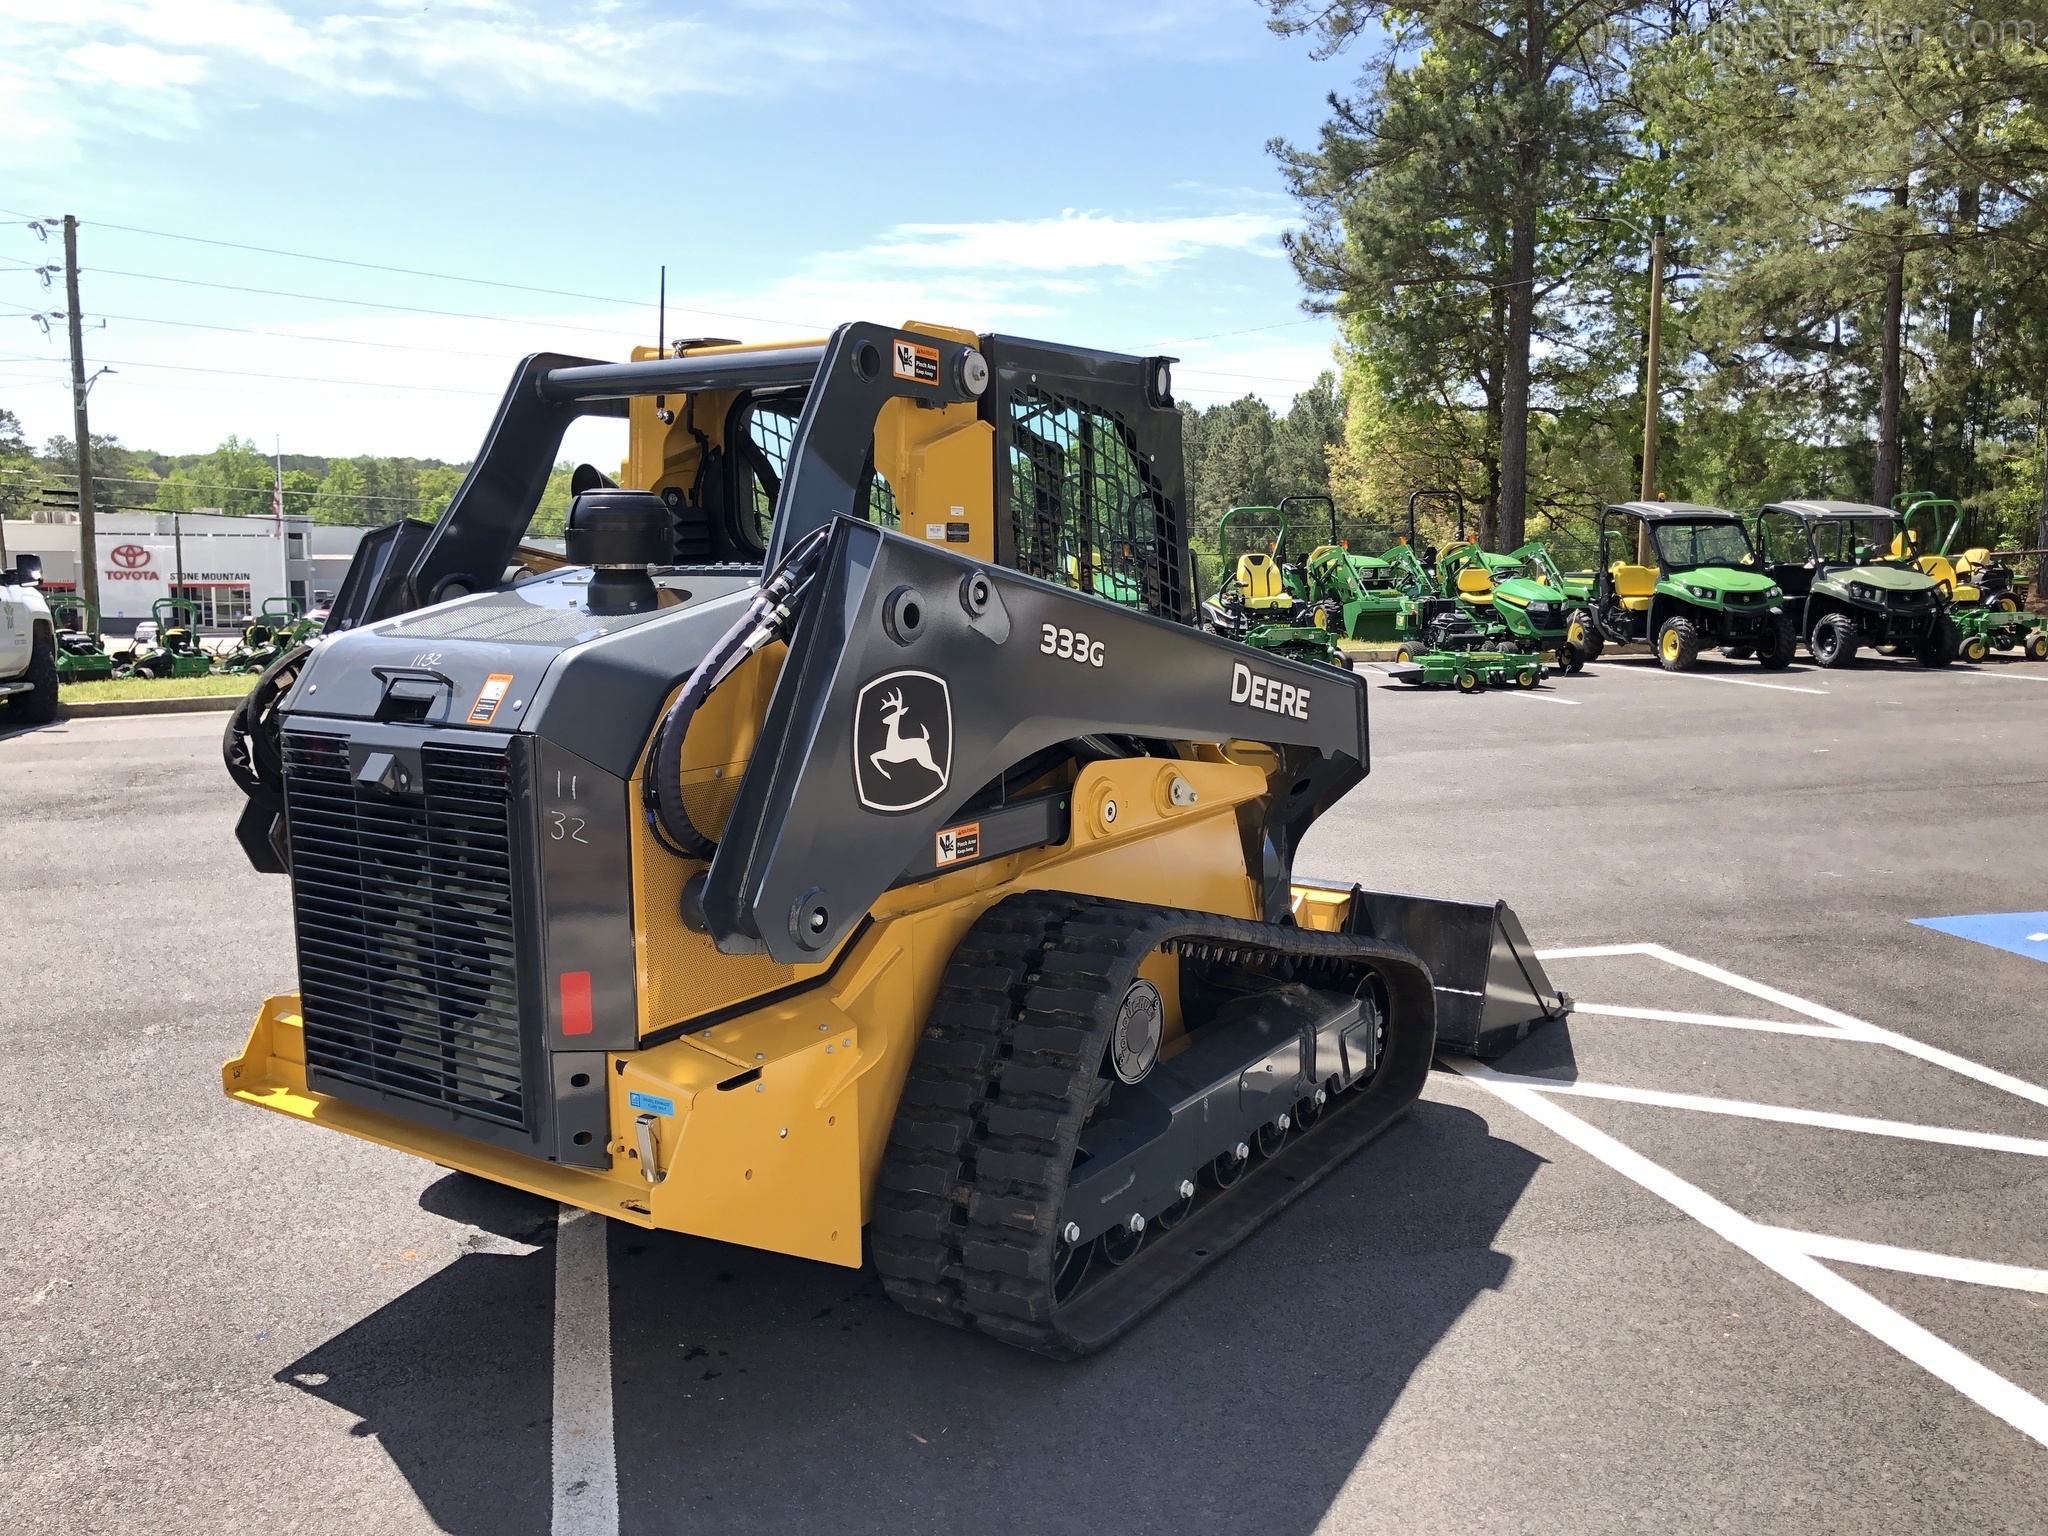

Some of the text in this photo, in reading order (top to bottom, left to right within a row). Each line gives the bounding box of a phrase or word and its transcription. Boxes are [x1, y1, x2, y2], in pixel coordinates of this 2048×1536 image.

[105, 570, 159, 581] TOYOTA
[169, 572, 250, 581] SONE MOUNTAIN
[410, 652, 443, 668] 1132
[1039, 622, 1106, 668] 333G
[1230, 661, 1312, 721] DEERE
[556, 770, 578, 800] 11
[549, 810, 589, 845] 32
